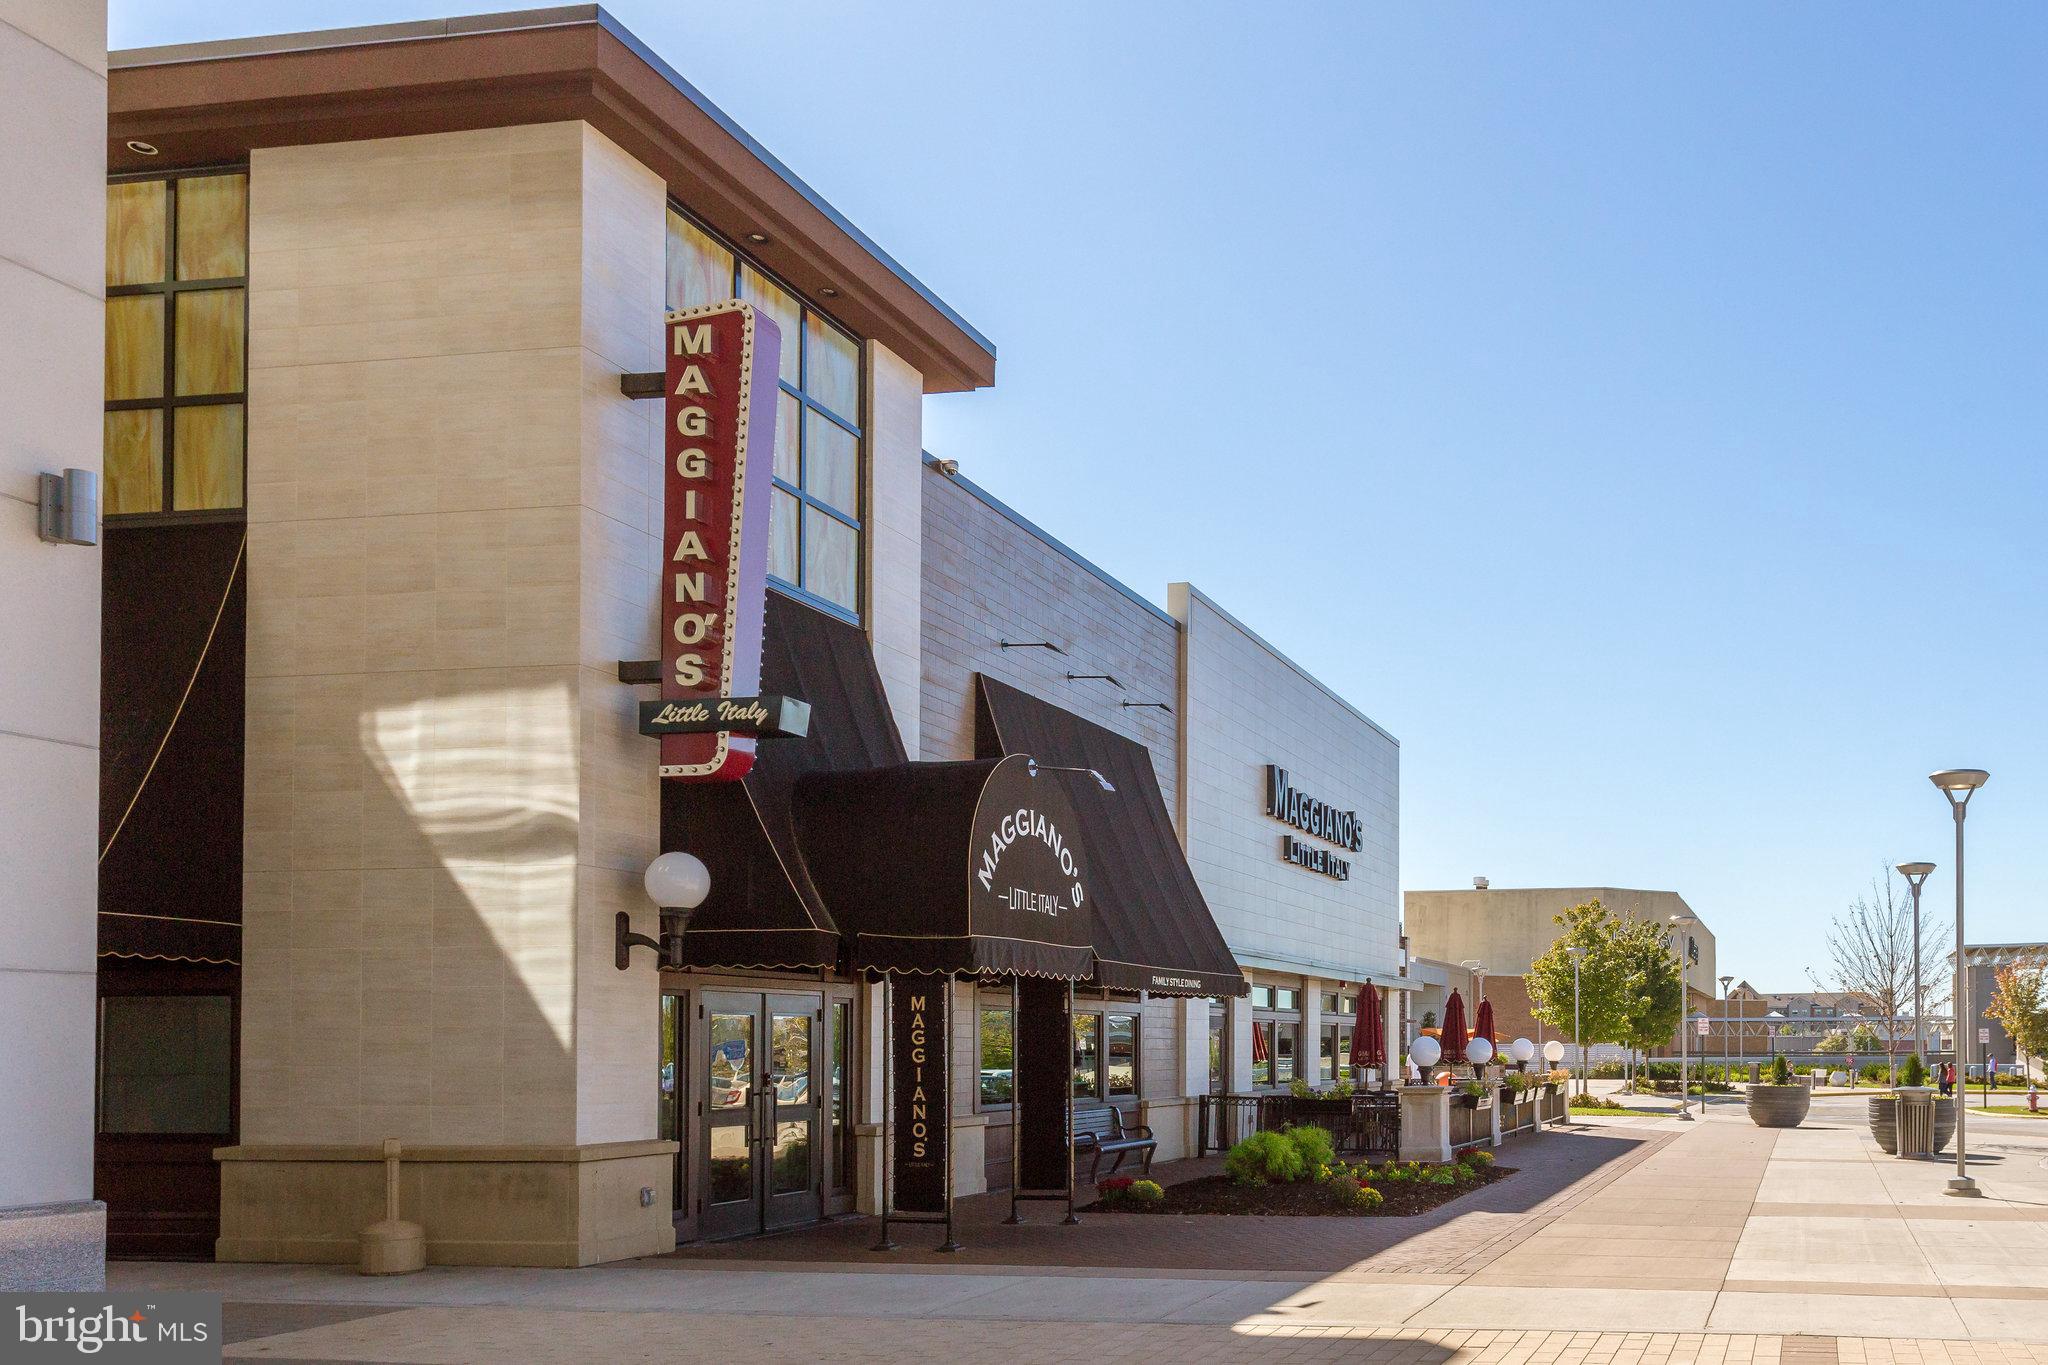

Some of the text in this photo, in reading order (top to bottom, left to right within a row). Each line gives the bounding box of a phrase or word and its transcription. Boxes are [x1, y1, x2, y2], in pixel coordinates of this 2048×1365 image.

[672, 323, 717, 687] MAGGIANO'S
[651, 700, 769, 726] Little Italy
[1267, 764, 1363, 852] MAGGIANO'S
[977, 808, 1084, 908] MAGGIANO'S
[1284, 835, 1351, 881] LITTLE ITALY
[1009, 886, 1059, 917] LITTLE ITALY
[1151, 975, 1201, 989] FAMILY STYLE DINING
[911, 996, 928, 1158] MAGGIANO'S
